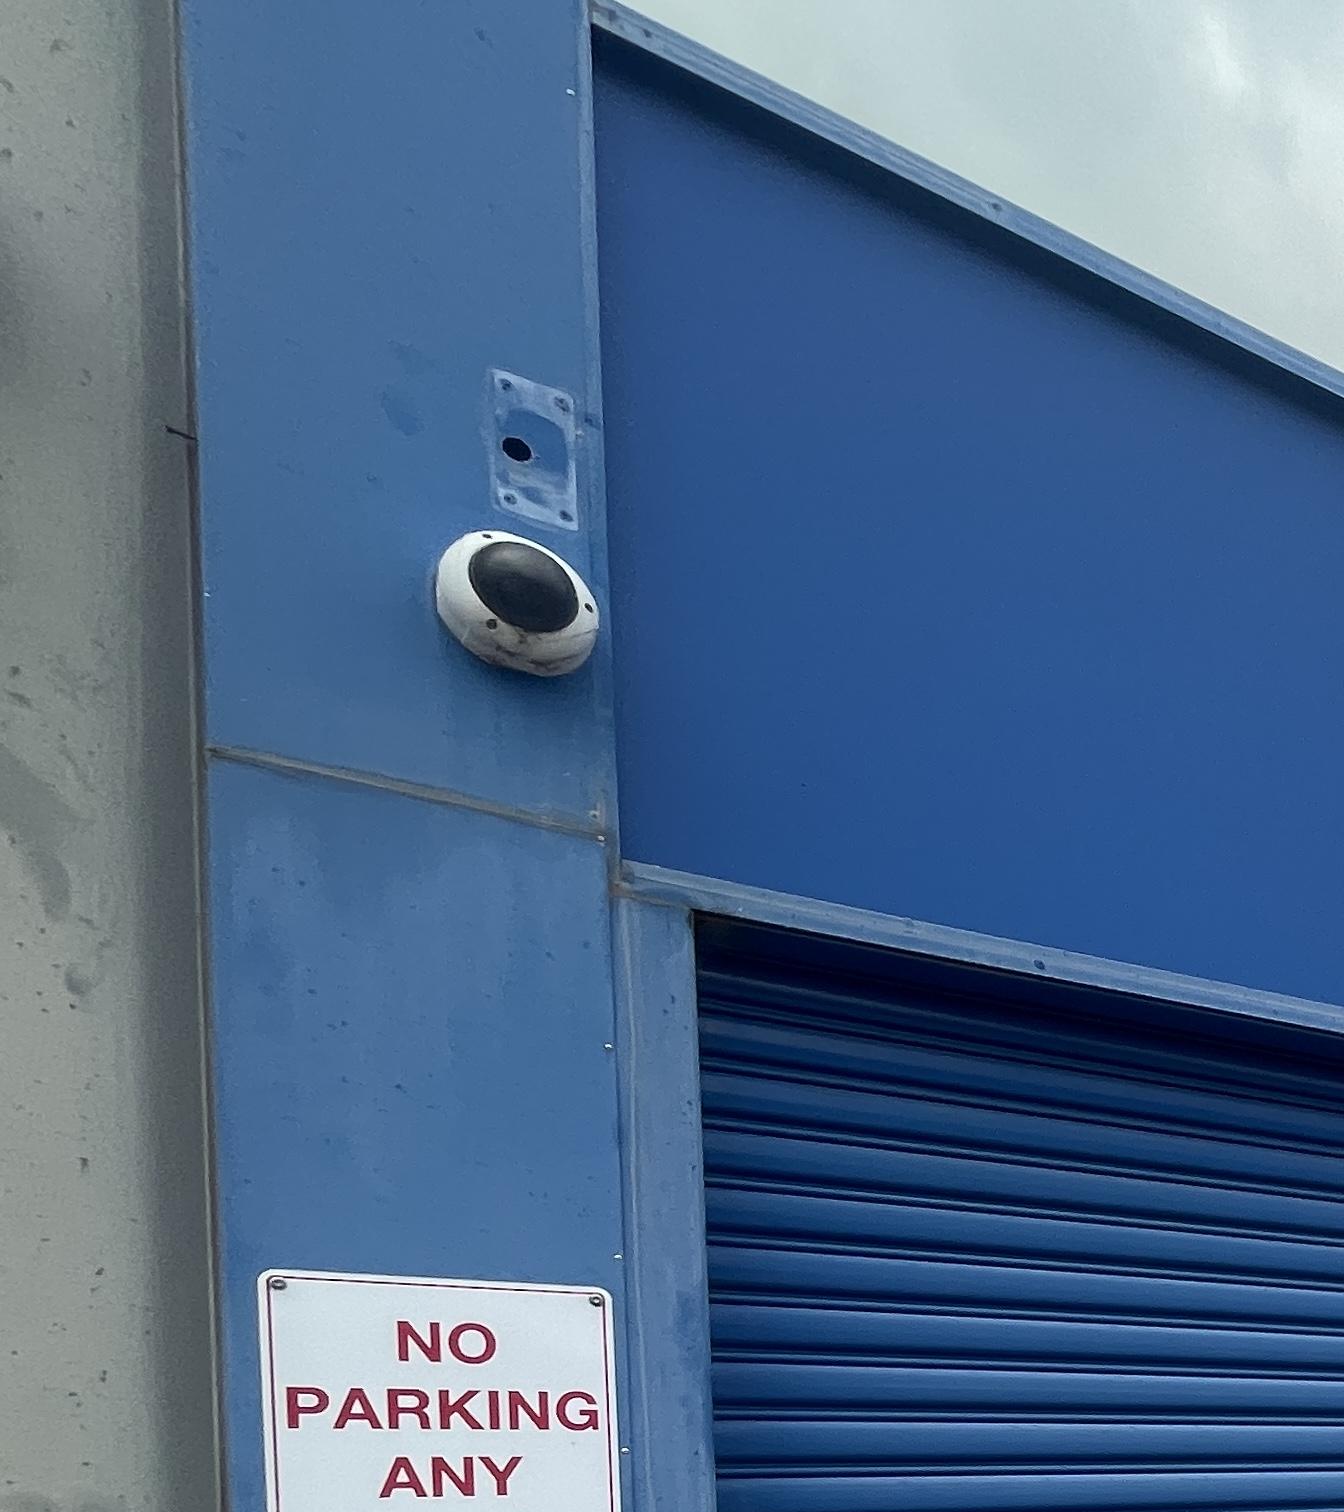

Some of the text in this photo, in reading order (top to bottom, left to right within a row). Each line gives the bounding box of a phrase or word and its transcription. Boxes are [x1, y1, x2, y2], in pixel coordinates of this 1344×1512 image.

[396, 1320, 497, 1364] NO
[285, 1386, 600, 1431] PARKING
[378, 1455, 523, 1499] ANY
